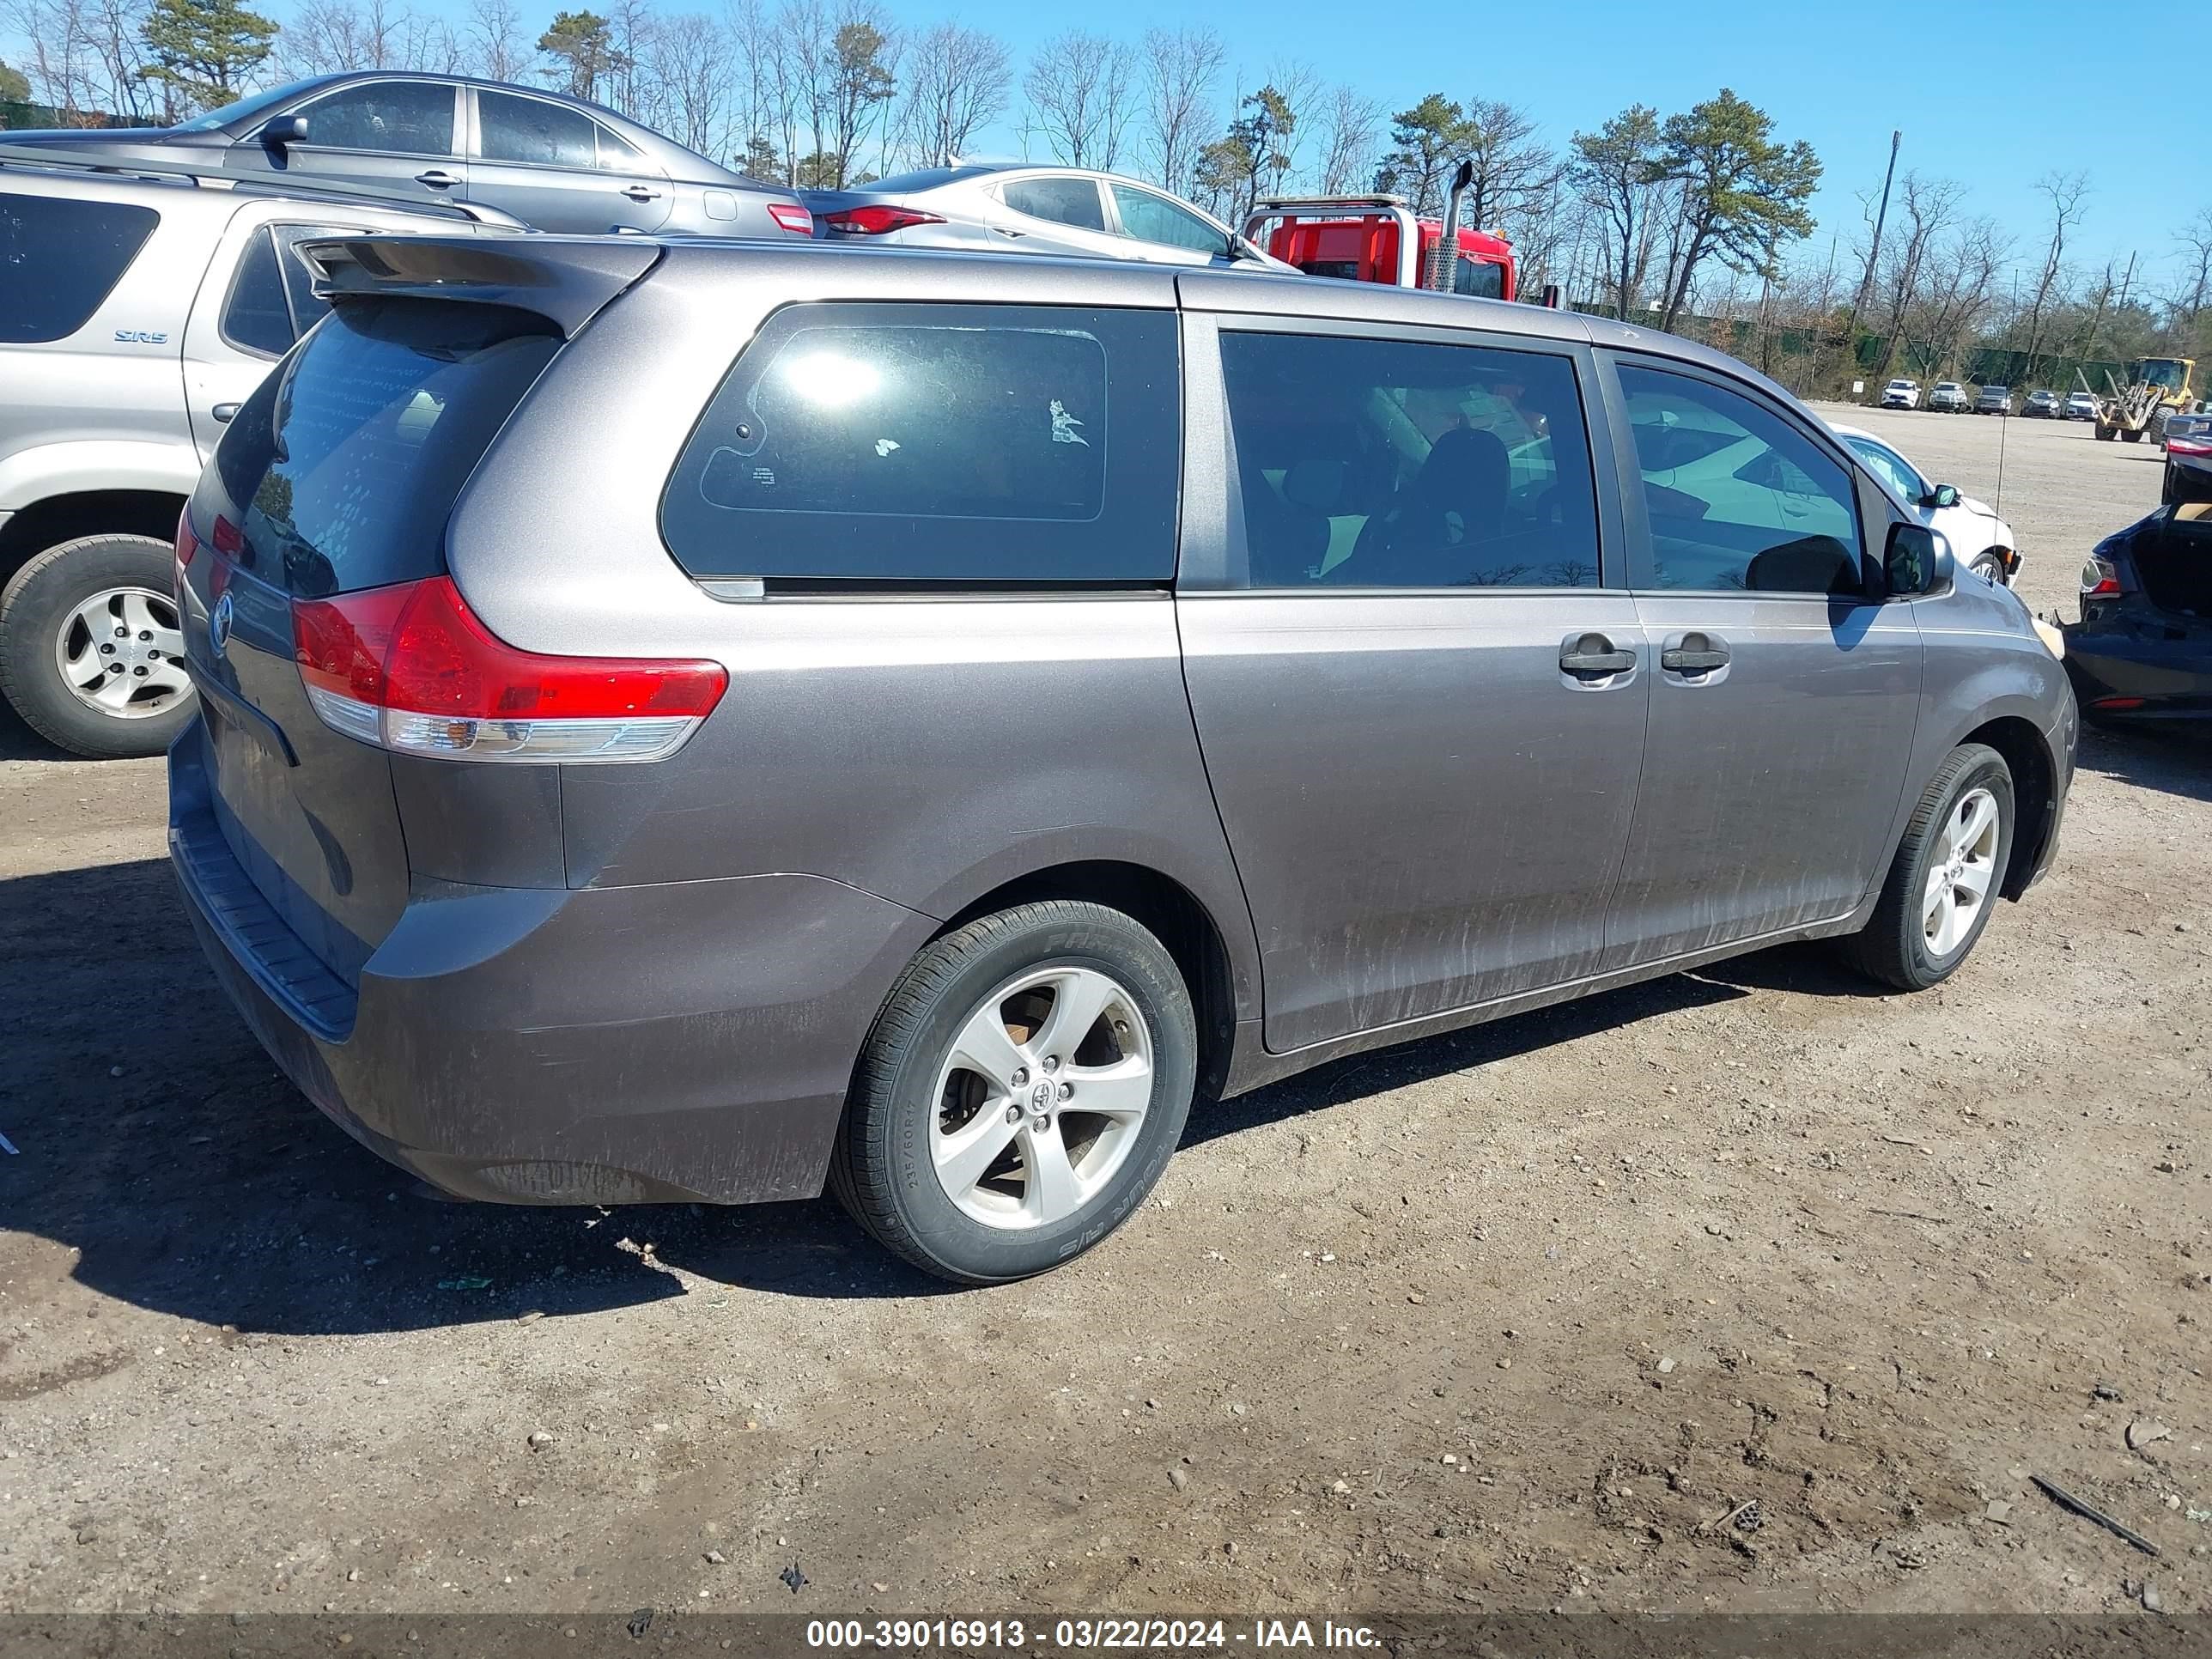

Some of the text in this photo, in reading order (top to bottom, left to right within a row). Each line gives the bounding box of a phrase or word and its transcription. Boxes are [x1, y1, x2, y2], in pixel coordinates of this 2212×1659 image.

[114, 330, 167, 344] SR5
[903, 1100, 918, 1189] 235/60R17
[1113, 1142, 1167, 1220] TOUR
